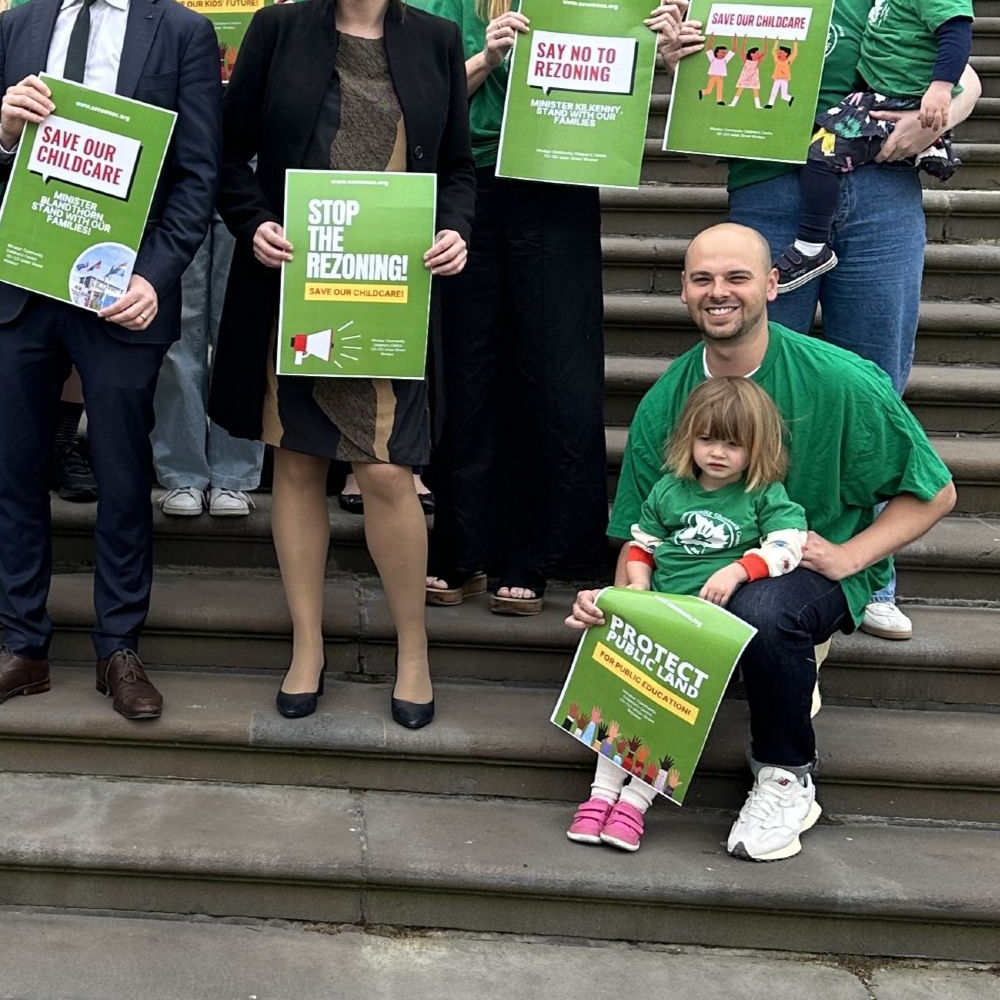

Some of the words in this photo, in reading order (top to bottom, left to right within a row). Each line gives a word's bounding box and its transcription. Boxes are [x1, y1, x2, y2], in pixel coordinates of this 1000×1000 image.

[187, 0, 203, 8] OUR
[226, 0, 259, 7] FUTURE!
[712, 13, 736, 26] SAVE
[736, 14, 755, 27] OUR
[756, 16, 806, 29] CHILDCARE
[537, 42, 566, 59] SAY
[571, 46, 591, 61] NO
[597, 48, 616, 63] TO
[534, 61, 611, 82] REZONING
[531, 99, 574, 111] MINISTER
[536, 109, 568, 118] STAND
[569, 110, 595, 119] WITH
[597, 112, 616, 121] OUR
[554, 118, 596, 127] FAMILIES
[42, 126, 81, 152] SAVE
[83, 139, 117, 162] OUR
[37, 146, 123, 185] CHILDCARE
[54, 191, 98, 209] MINISTER
[31, 202, 63, 217] STAND
[65, 212, 90, 226] WITH
[91, 219, 111, 233] OUR
[309, 199, 360, 225] STOP
[46, 217, 91, 236] FAMILIES!
[308, 226, 344, 252] THE
[307, 253, 408, 281] REZONING!
[309, 287, 333, 296] SAVE
[333, 288, 352, 296] OUR
[354, 289, 404, 298] CHILDCARE!
[611, 615, 709, 688] PROTECT
[606, 630, 655, 671] PUBLIC
[657, 664, 700, 699] LAND
[599, 650, 616, 666] FOR
[615, 658, 643, 685] PUBLIC
[641, 682, 692, 715] EDUCATION!
